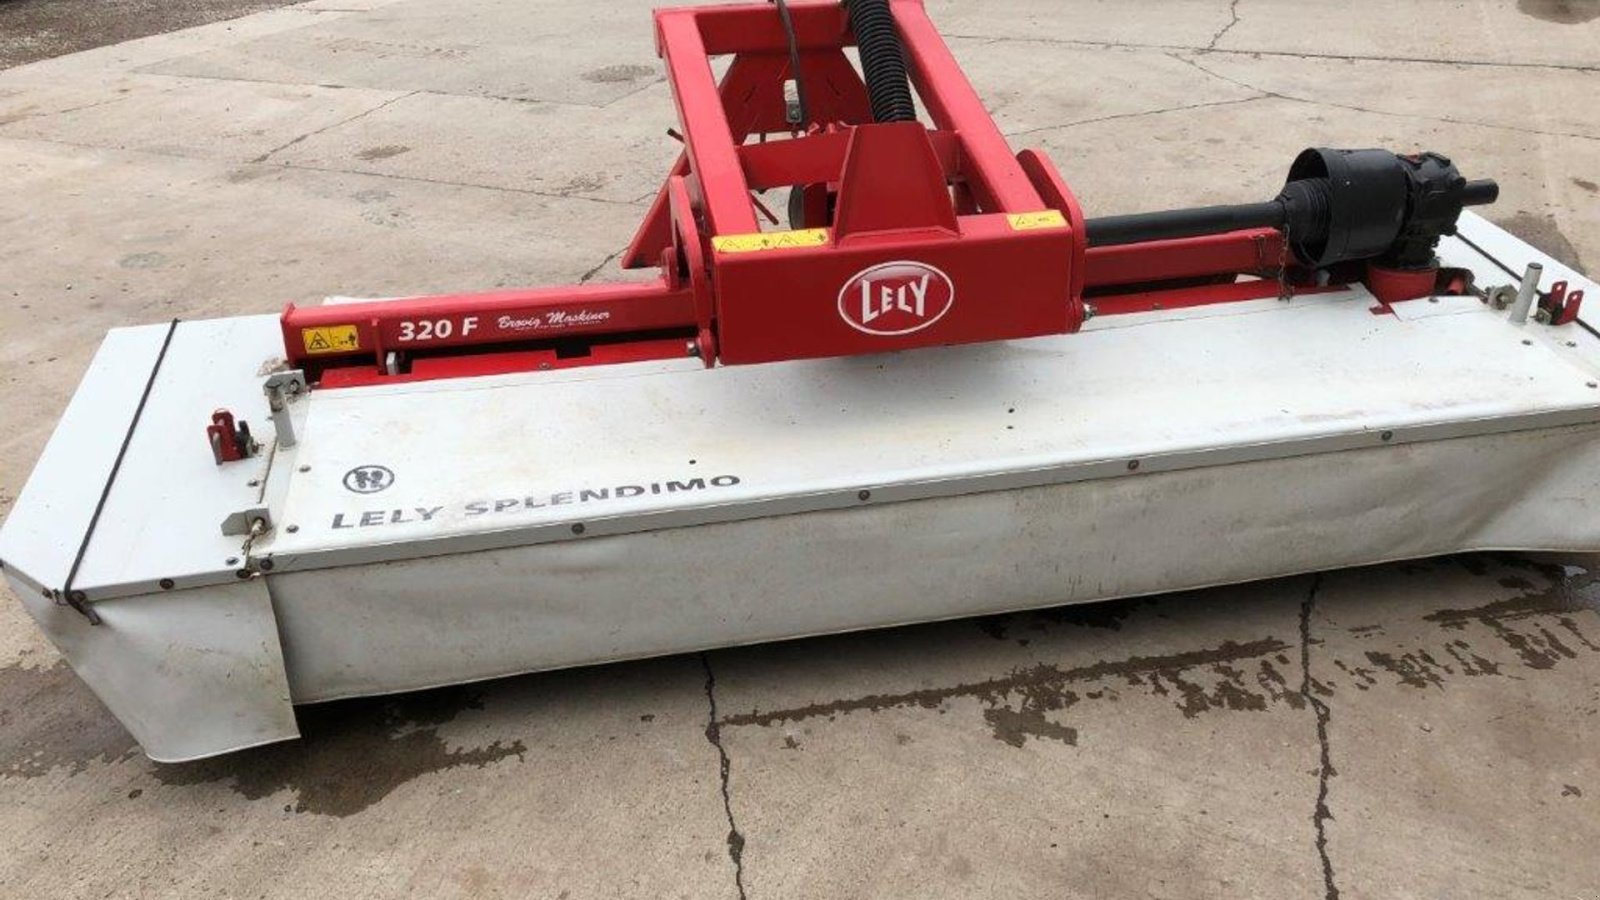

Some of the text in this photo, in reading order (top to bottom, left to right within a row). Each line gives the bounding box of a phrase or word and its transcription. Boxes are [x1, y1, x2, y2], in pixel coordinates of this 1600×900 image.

[546, 310, 610, 324] Maskiner
[862, 273, 930, 324] LELY
[398, 317, 479, 341] 320 F
[331, 475, 741, 529] LELY SPLENDIMO
